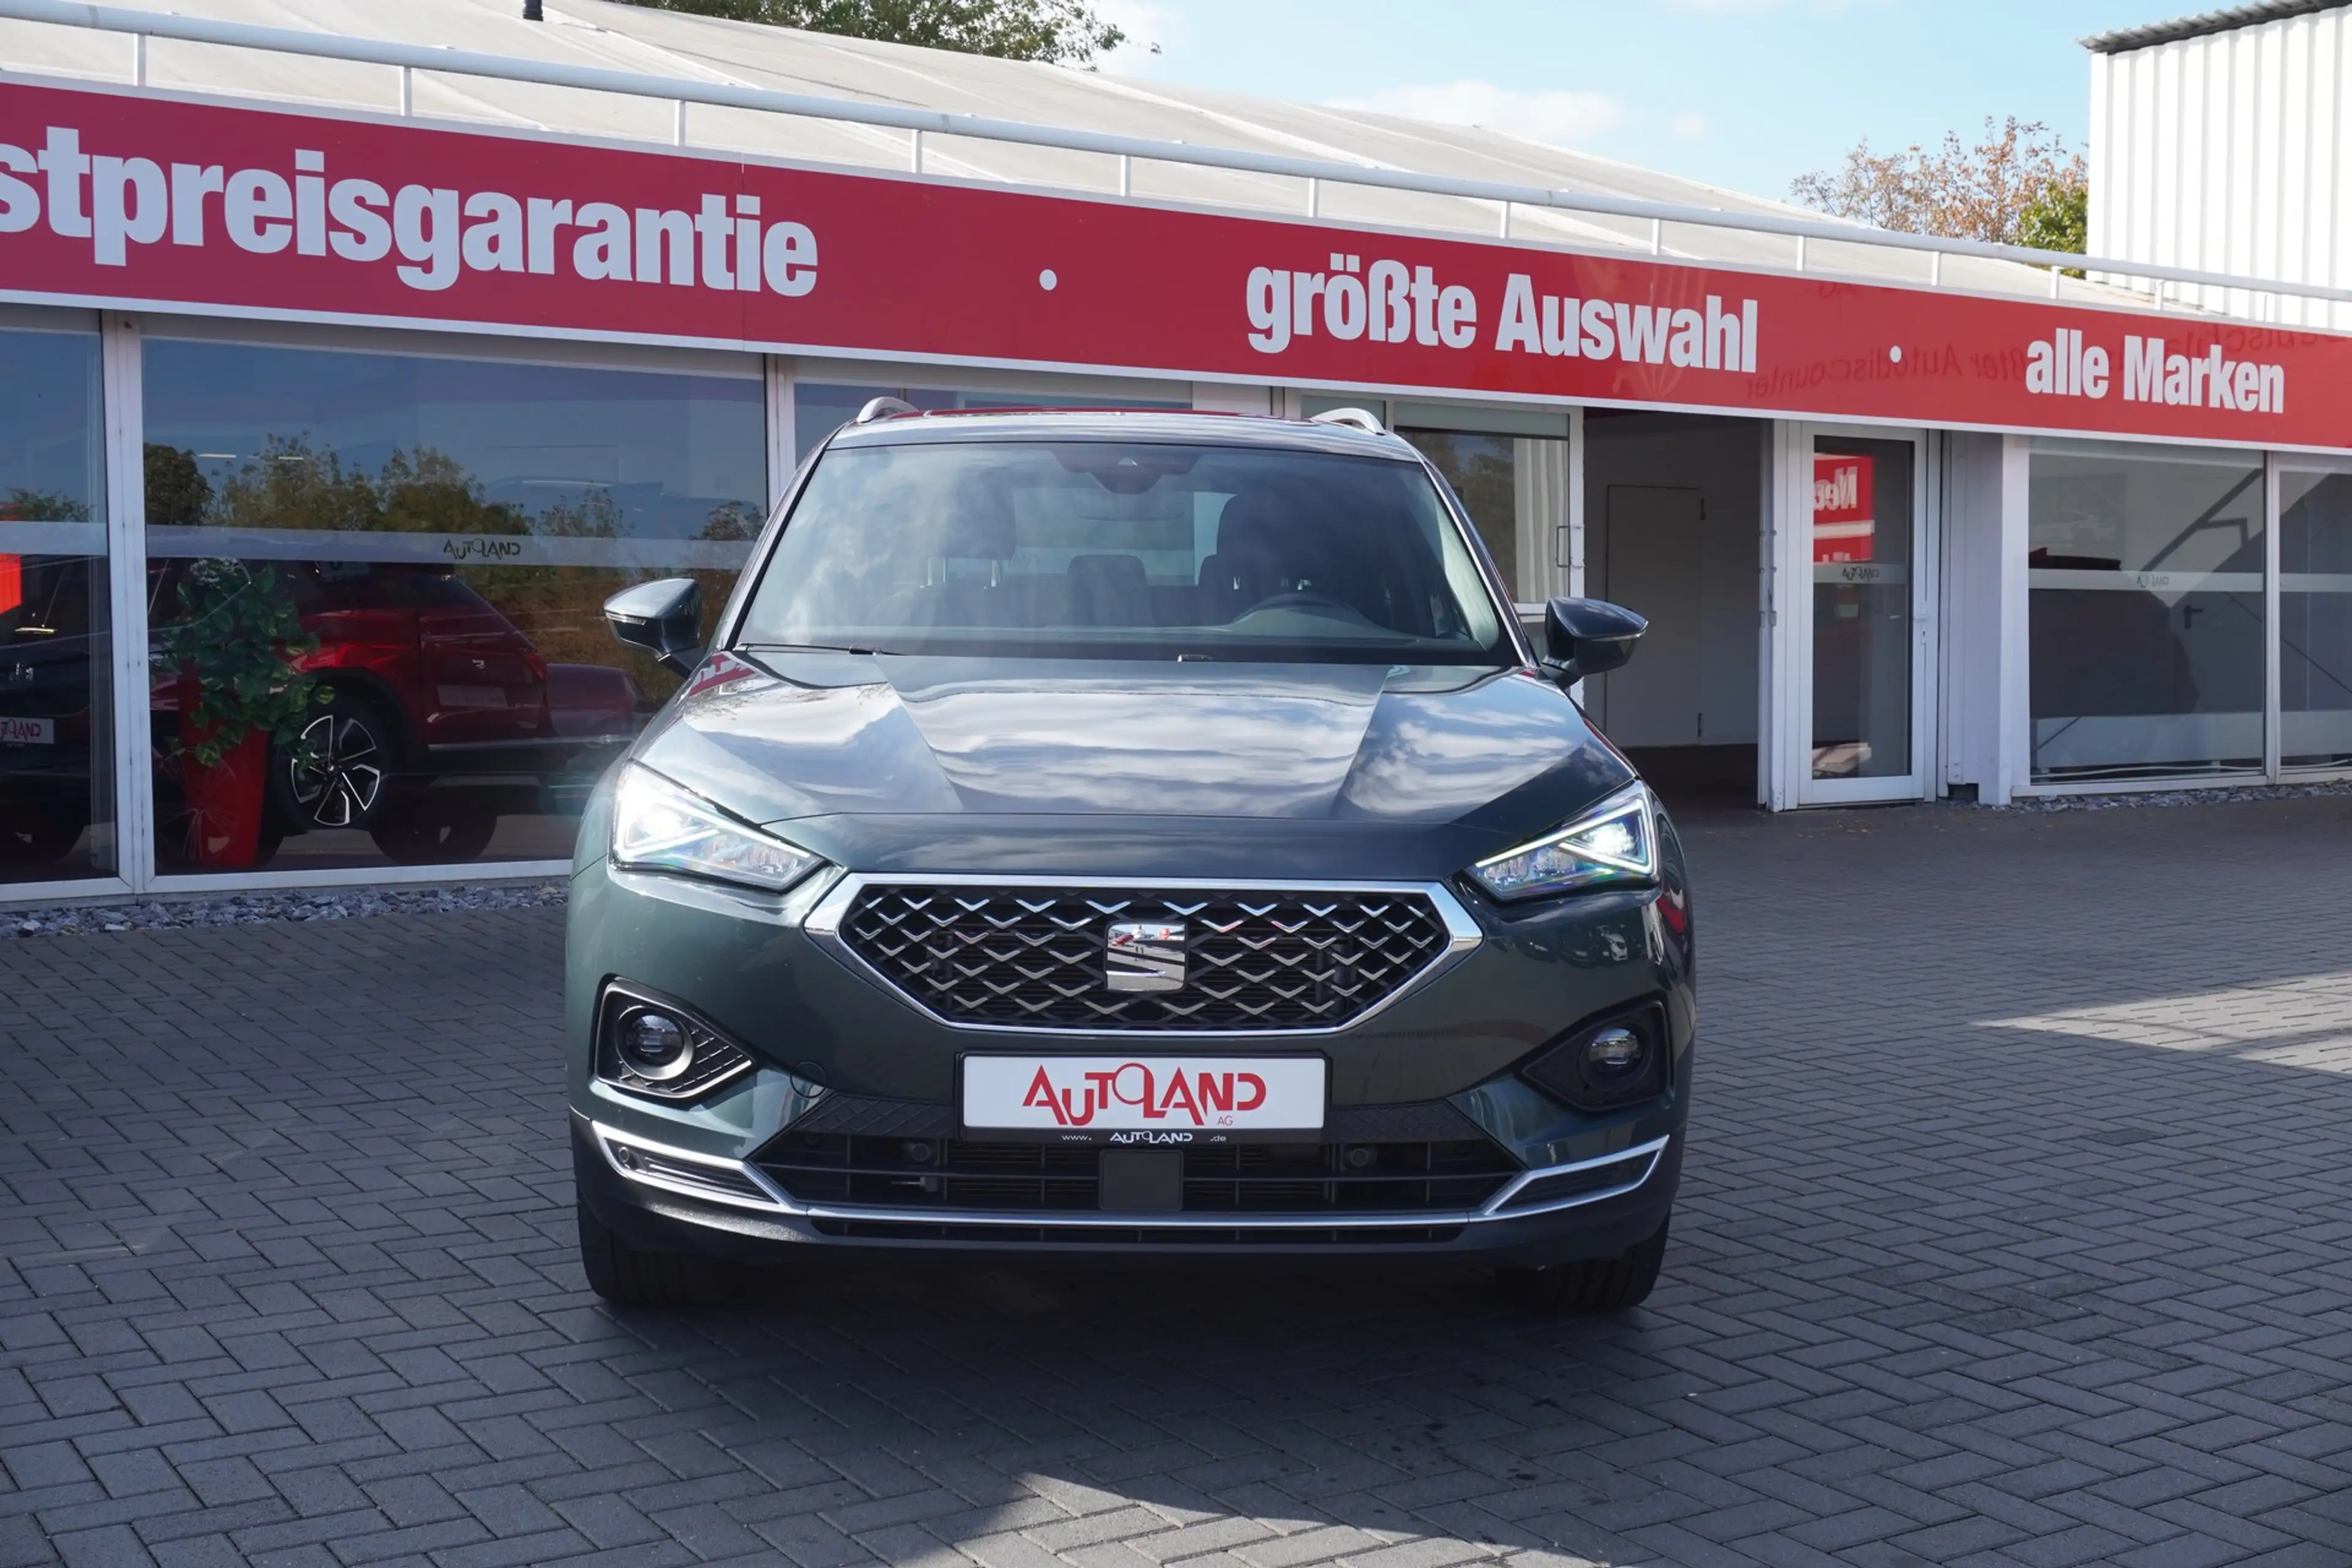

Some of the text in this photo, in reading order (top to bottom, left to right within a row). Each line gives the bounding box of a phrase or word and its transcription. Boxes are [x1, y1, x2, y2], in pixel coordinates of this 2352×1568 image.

[1246, 252, 1758, 374] größte Auswahl
[2026, 327, 2285, 415] alle Marken
[443, 537, 521, 560] AUTOLAND
[1023, 1063, 1267, 1126] AUTOLAND
[1109, 1131, 1193, 1144] AUTOLAND
[1216, 1115, 1234, 1126] AG
